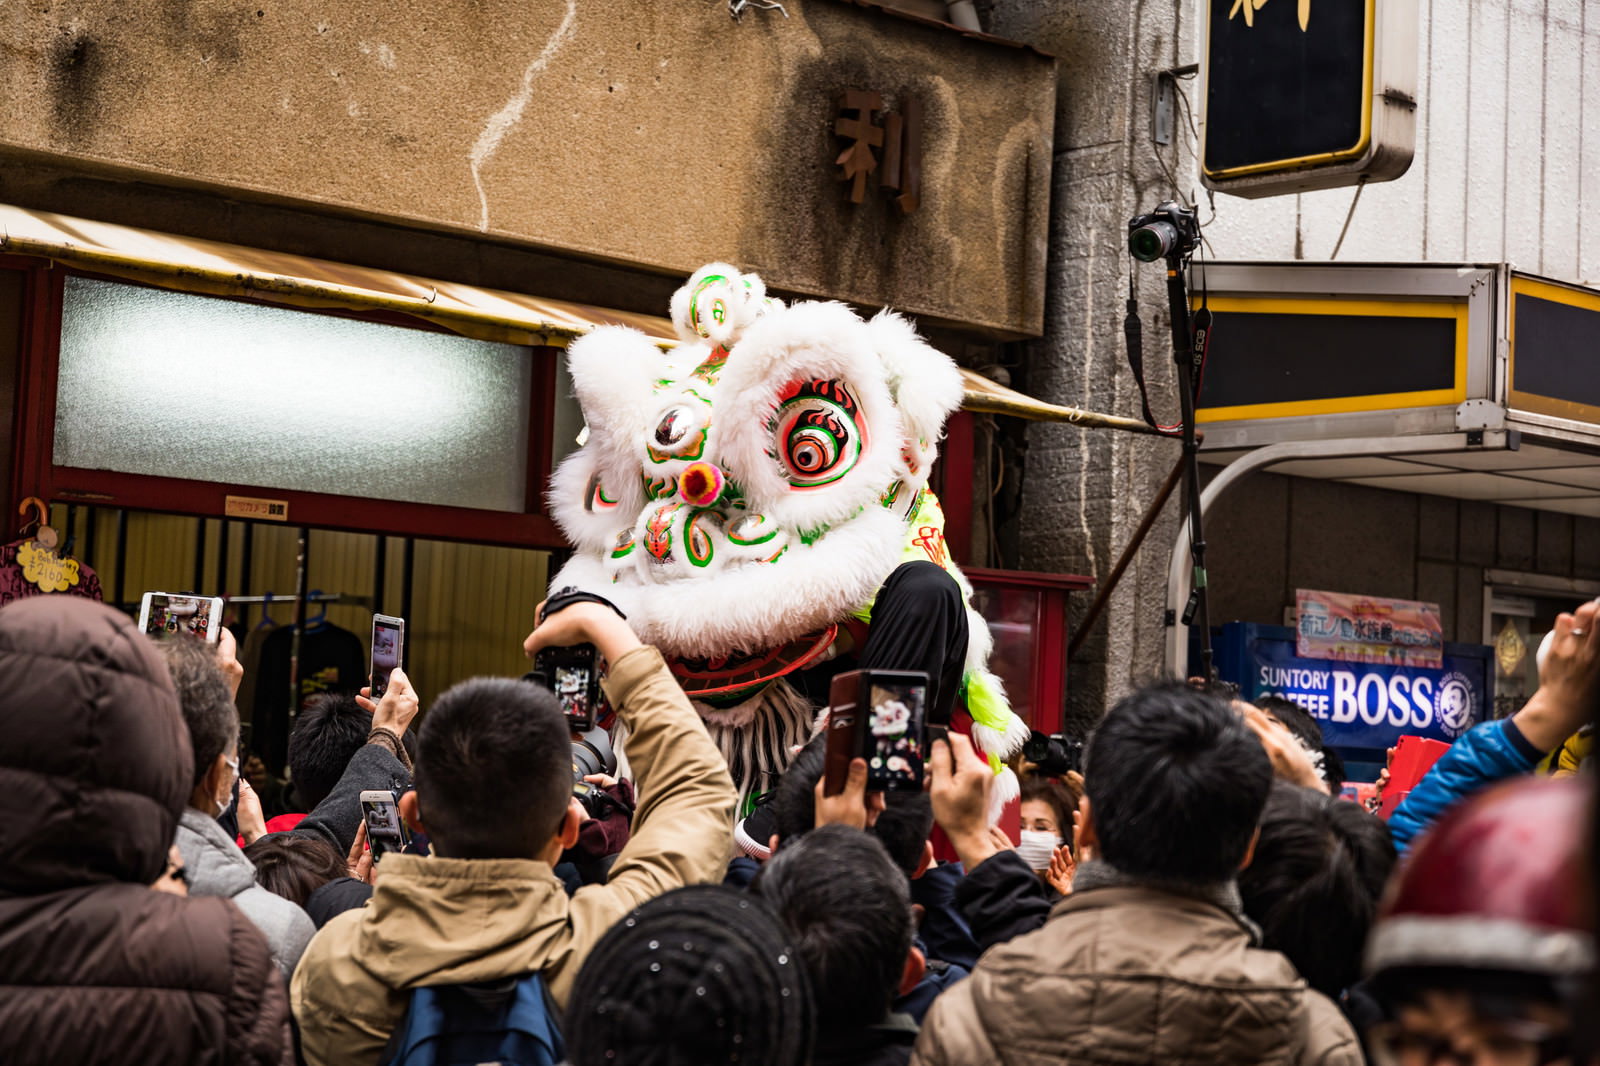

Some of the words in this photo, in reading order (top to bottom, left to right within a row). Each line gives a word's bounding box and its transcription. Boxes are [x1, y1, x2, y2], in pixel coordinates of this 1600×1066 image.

[1195, 329, 1206, 352] EOS
[1260, 666, 1330, 690] SUNTORY
[1259, 691, 1329, 719] FEE
[1331, 670, 1434, 728] BOSS
